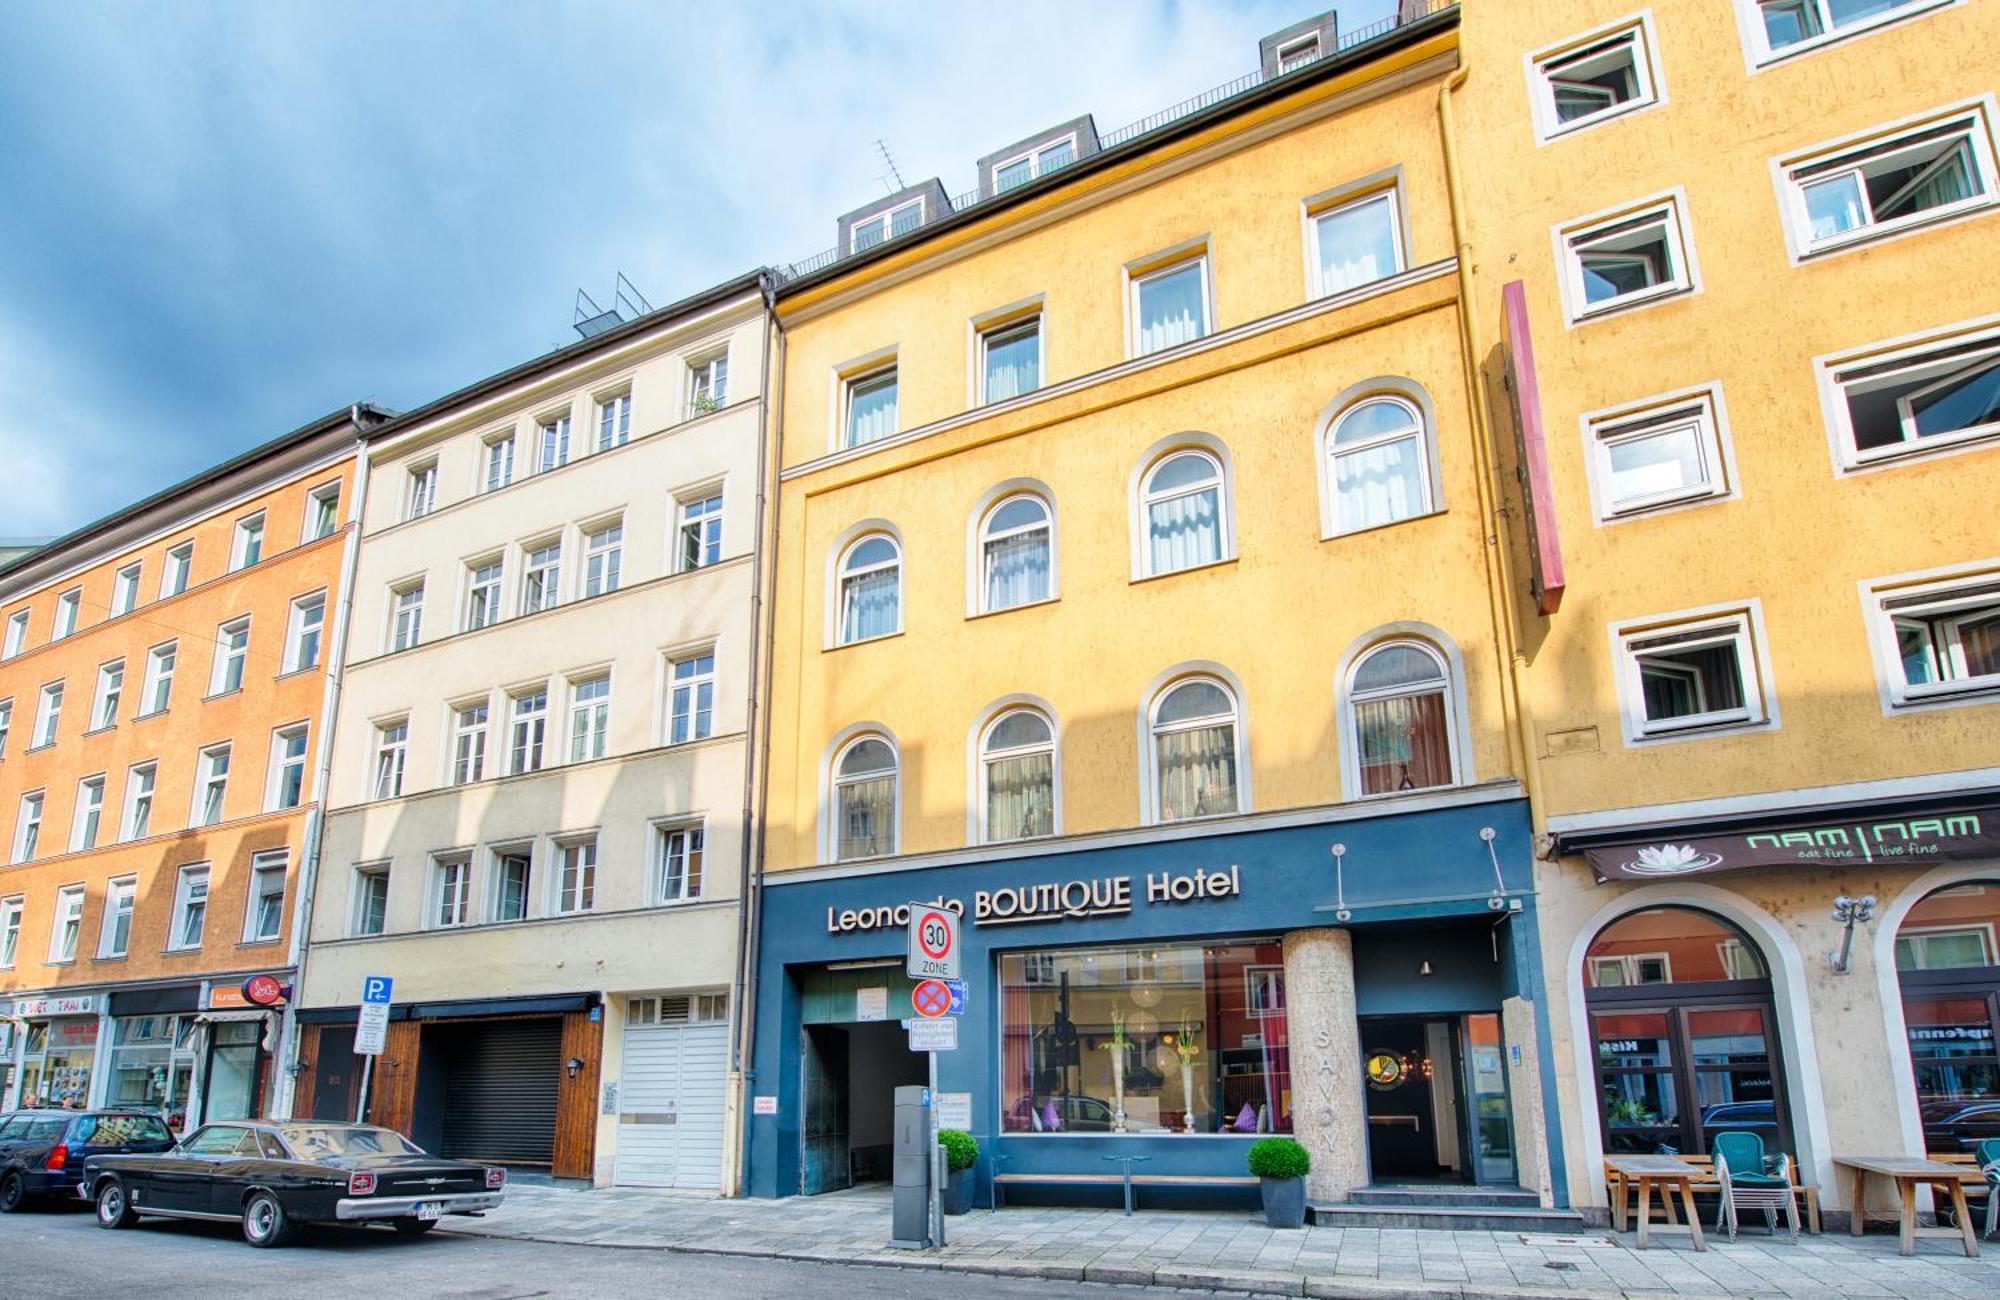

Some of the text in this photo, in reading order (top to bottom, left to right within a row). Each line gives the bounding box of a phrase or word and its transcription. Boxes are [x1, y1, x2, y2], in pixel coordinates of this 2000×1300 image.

[1797, 847, 1855, 859] eat fine
[1879, 842, 1939, 857] live fine
[827, 865, 1239, 932] Leonao BOUTIQUE Hotel
[926, 924, 945, 947] 30
[922, 961, 948, 975] ZONE
[1313, 1029, 1337, 1153] SAVOY
